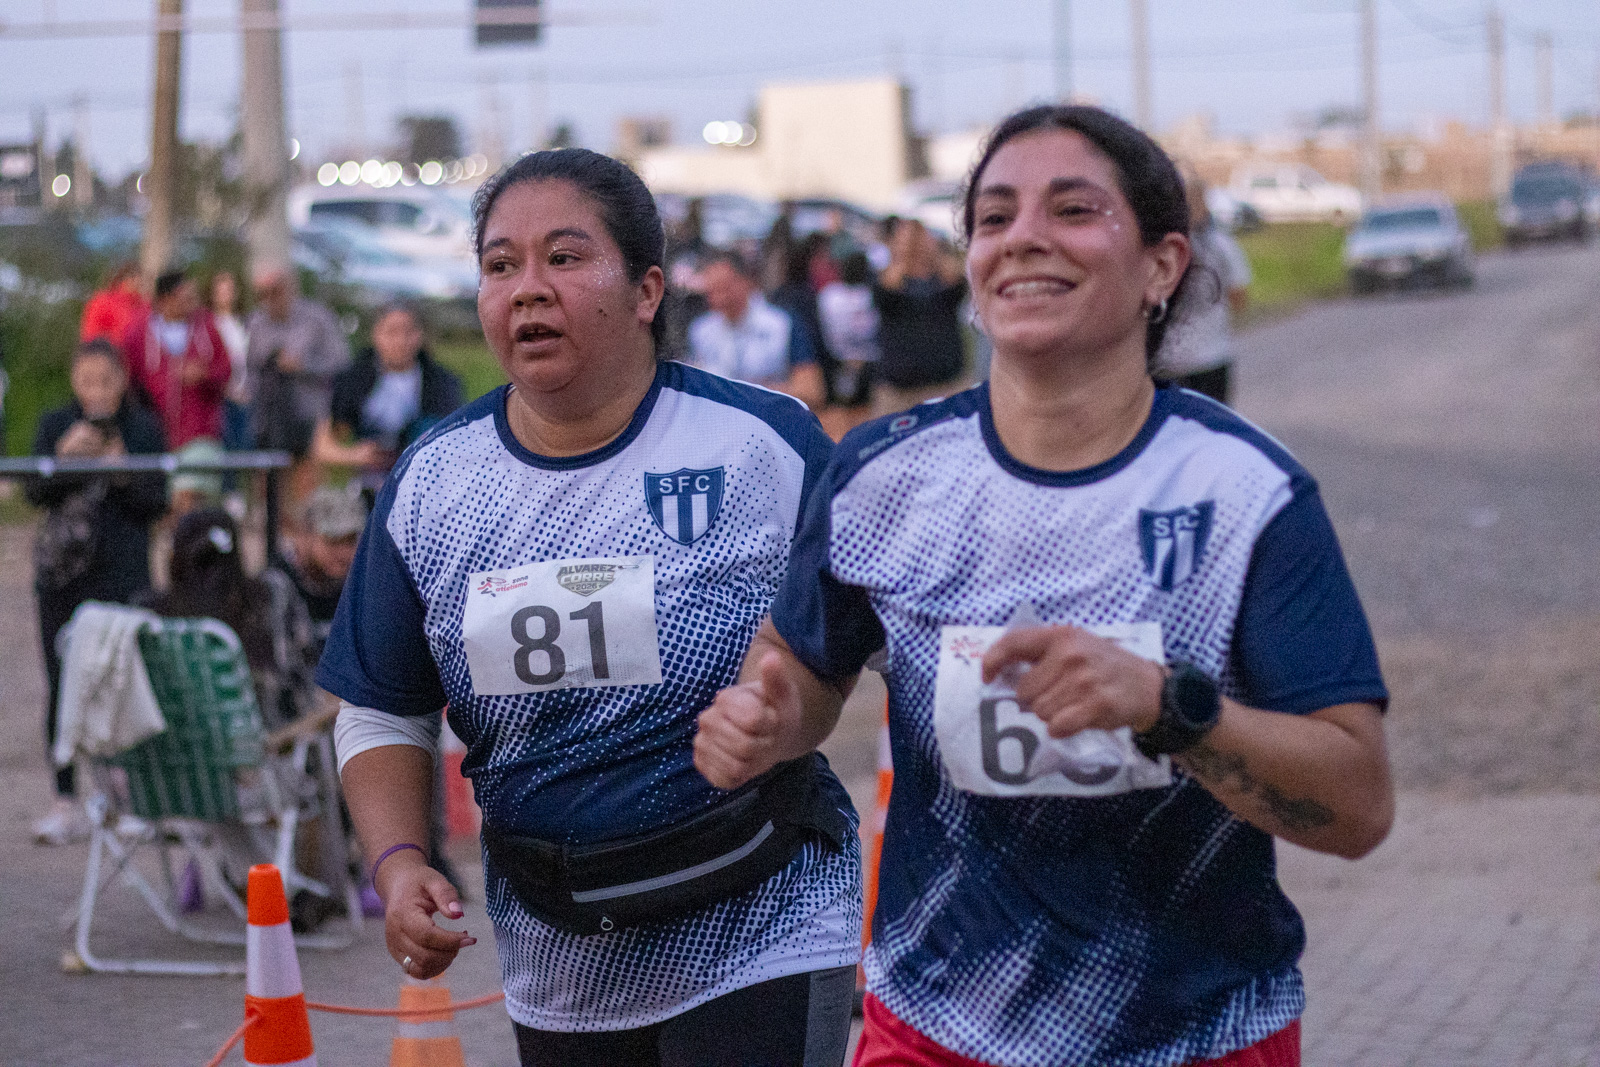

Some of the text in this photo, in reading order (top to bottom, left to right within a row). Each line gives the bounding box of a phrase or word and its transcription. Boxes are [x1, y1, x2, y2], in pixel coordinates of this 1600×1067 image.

[659, 474, 710, 494] SFC
[558, 563, 617, 575] ALVAREZ
[512, 575, 529, 584] zona
[560, 571, 615, 585] CORRE
[495, 581, 528, 592] atletismo
[575, 582, 598, 591] 2026
[511, 601, 610, 686] 81
